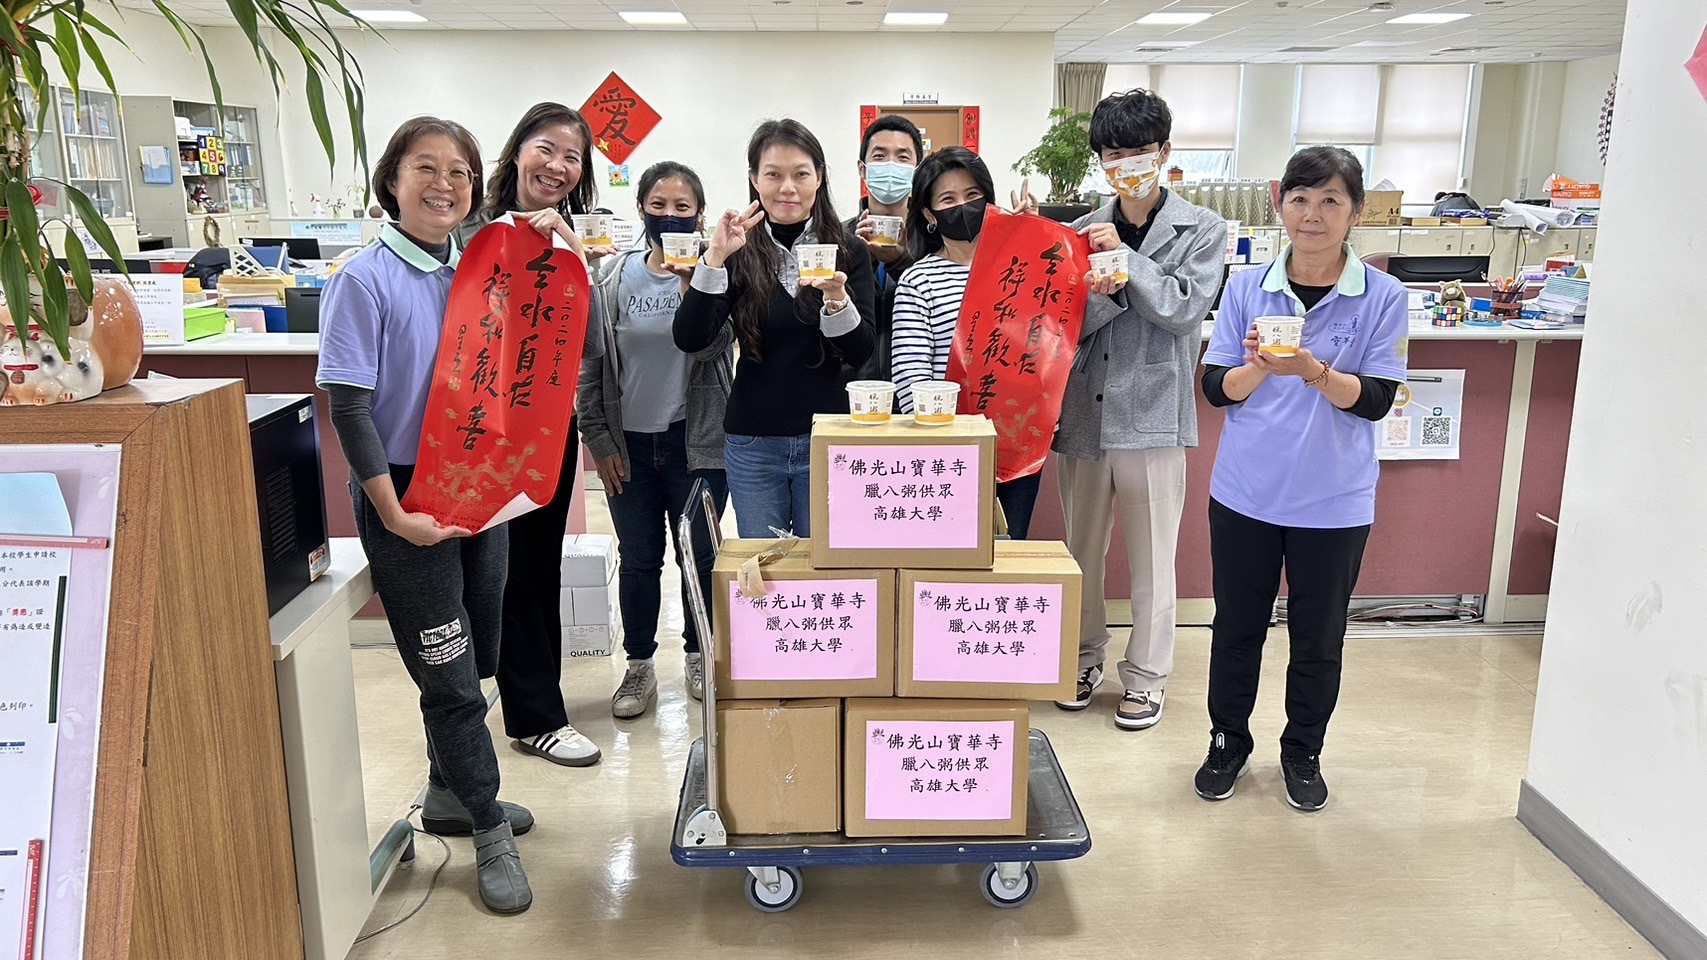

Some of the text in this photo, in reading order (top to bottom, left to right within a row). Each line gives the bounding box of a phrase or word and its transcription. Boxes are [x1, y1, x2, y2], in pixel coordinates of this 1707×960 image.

[592, 86, 637, 146] 愛
[200, 138, 222, 149] 1 2 3
[202, 151, 223, 161] 4 5 6
[203, 164, 208, 174] 7
[212, 165, 216, 173] 8
[1386, 207, 1399, 218] A4
[625, 291, 682, 317] PASADEN
[638, 309, 675, 318] CALIFORNI
[970, 255, 1029, 410] 祥和歡喜
[456, 262, 512, 450] 祥和歡喜
[849, 458, 967, 477] 佛光山寶華寺
[874, 505, 943, 521] 高雄大學
[750, 592, 866, 610] 佛光山寶華寺
[934, 595, 1050, 613] 佛光山寶華寺
[570, 649, 606, 658] QUALITY
[775, 638, 842, 653] 高雄大學
[957, 640, 1025, 656] 高雄大學
[887, 733, 1002, 751] 佛光山寶華寺
[910, 778, 978, 793] 高雄大學
